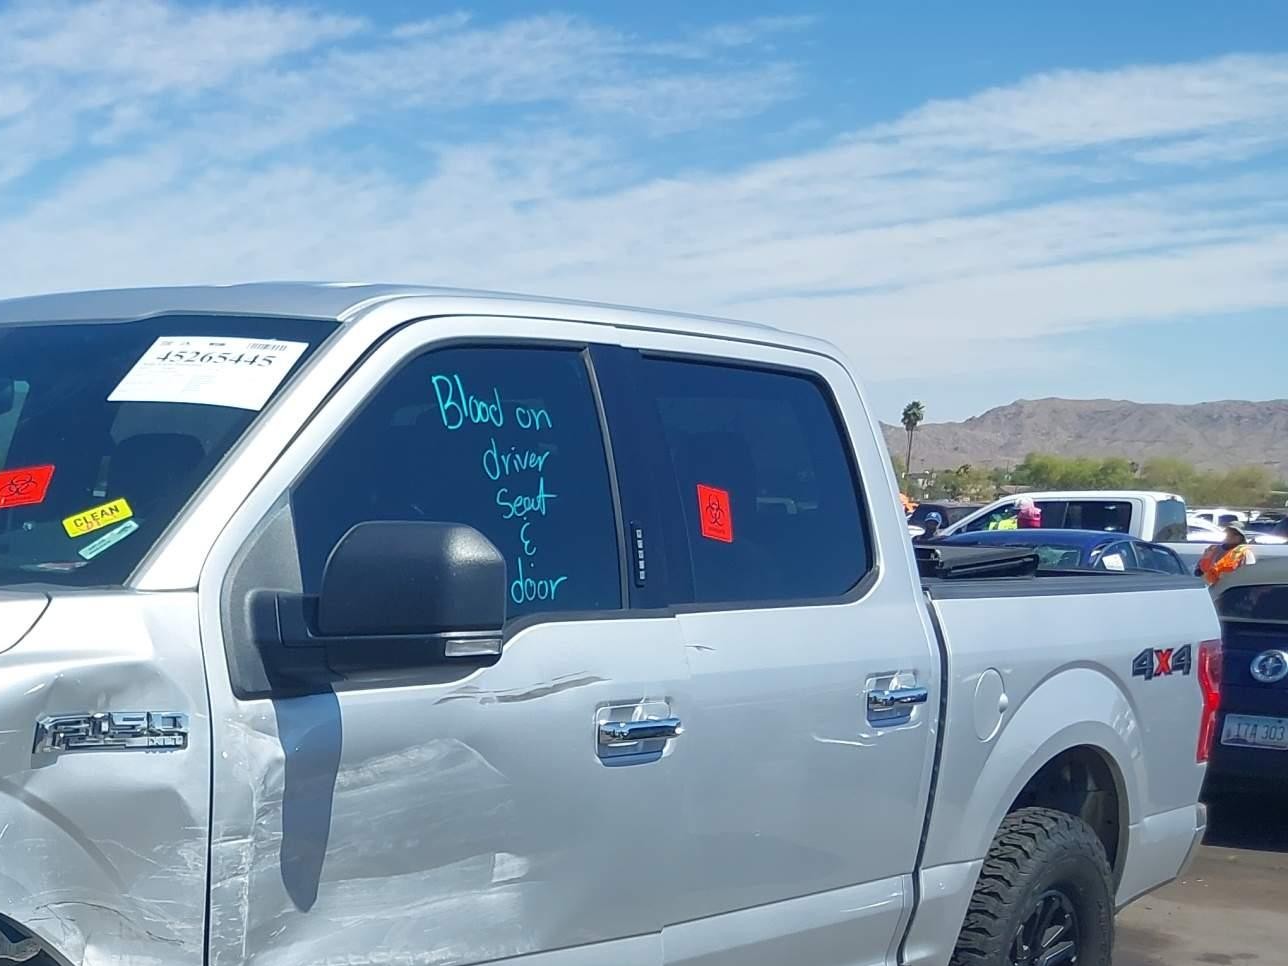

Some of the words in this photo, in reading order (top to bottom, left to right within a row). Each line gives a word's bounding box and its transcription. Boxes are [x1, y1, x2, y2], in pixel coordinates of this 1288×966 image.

[156, 350, 277, 367] 45265445
[431, 374, 504, 430] Blood
[515, 407, 553, 431] on
[482, 437, 551, 480] driver
[72, 504, 120, 529] CLEAN
[510, 557, 568, 604] door
